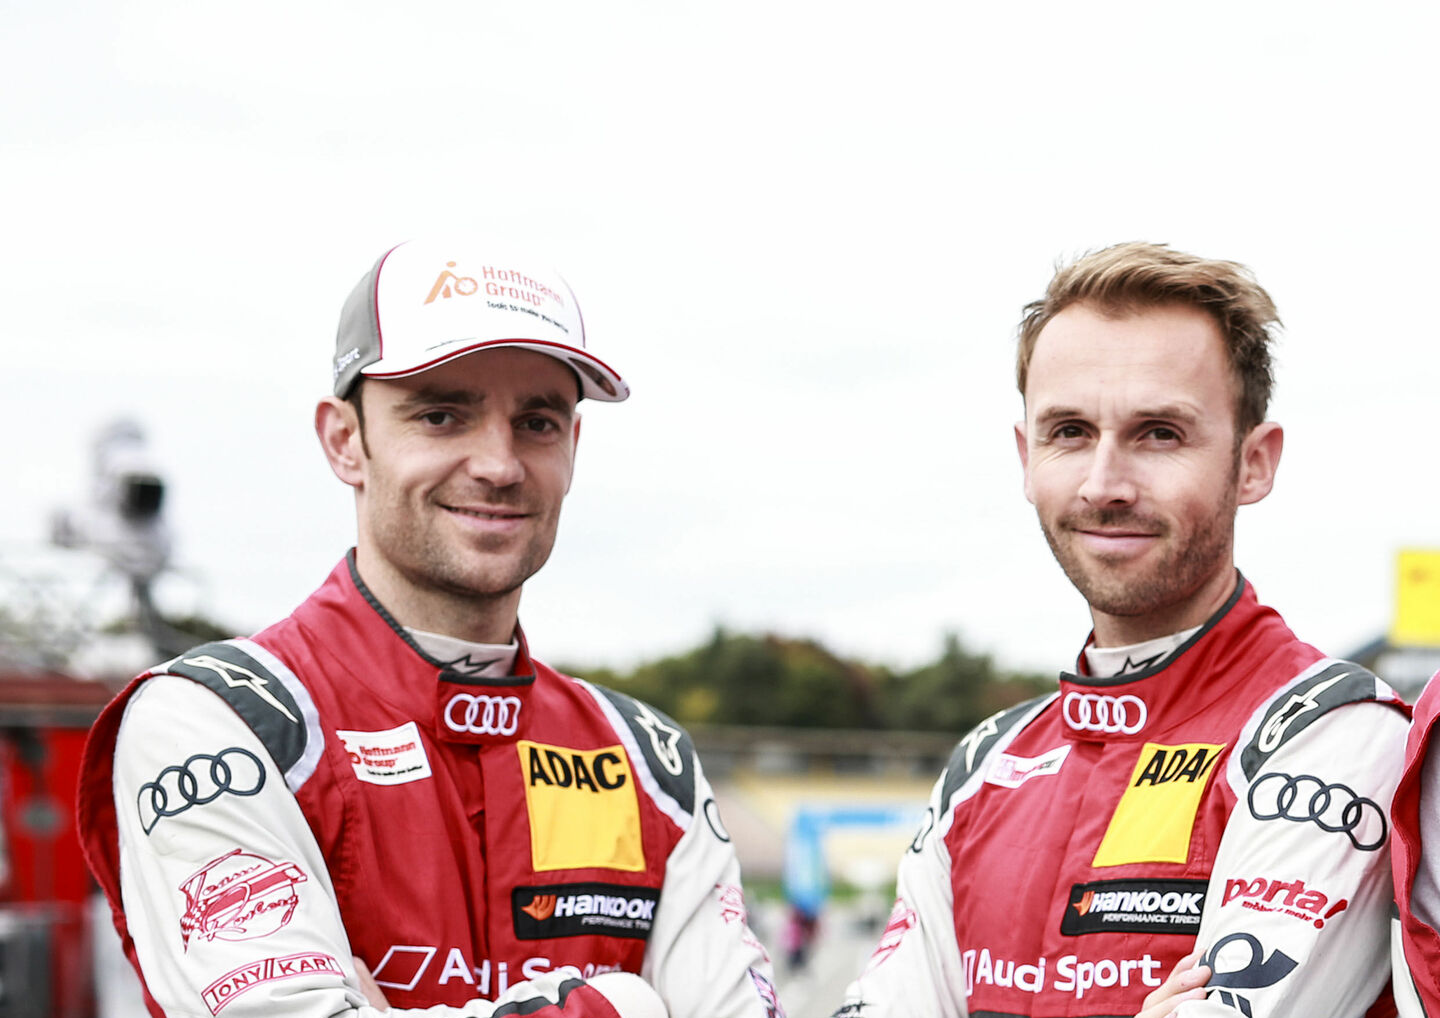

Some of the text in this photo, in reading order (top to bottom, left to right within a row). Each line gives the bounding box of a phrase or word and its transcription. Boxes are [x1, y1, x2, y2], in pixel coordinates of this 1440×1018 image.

[486, 281, 541, 306] Group
[530, 747, 627, 793] ADAC
[1054, 954, 1161, 999] Sport
